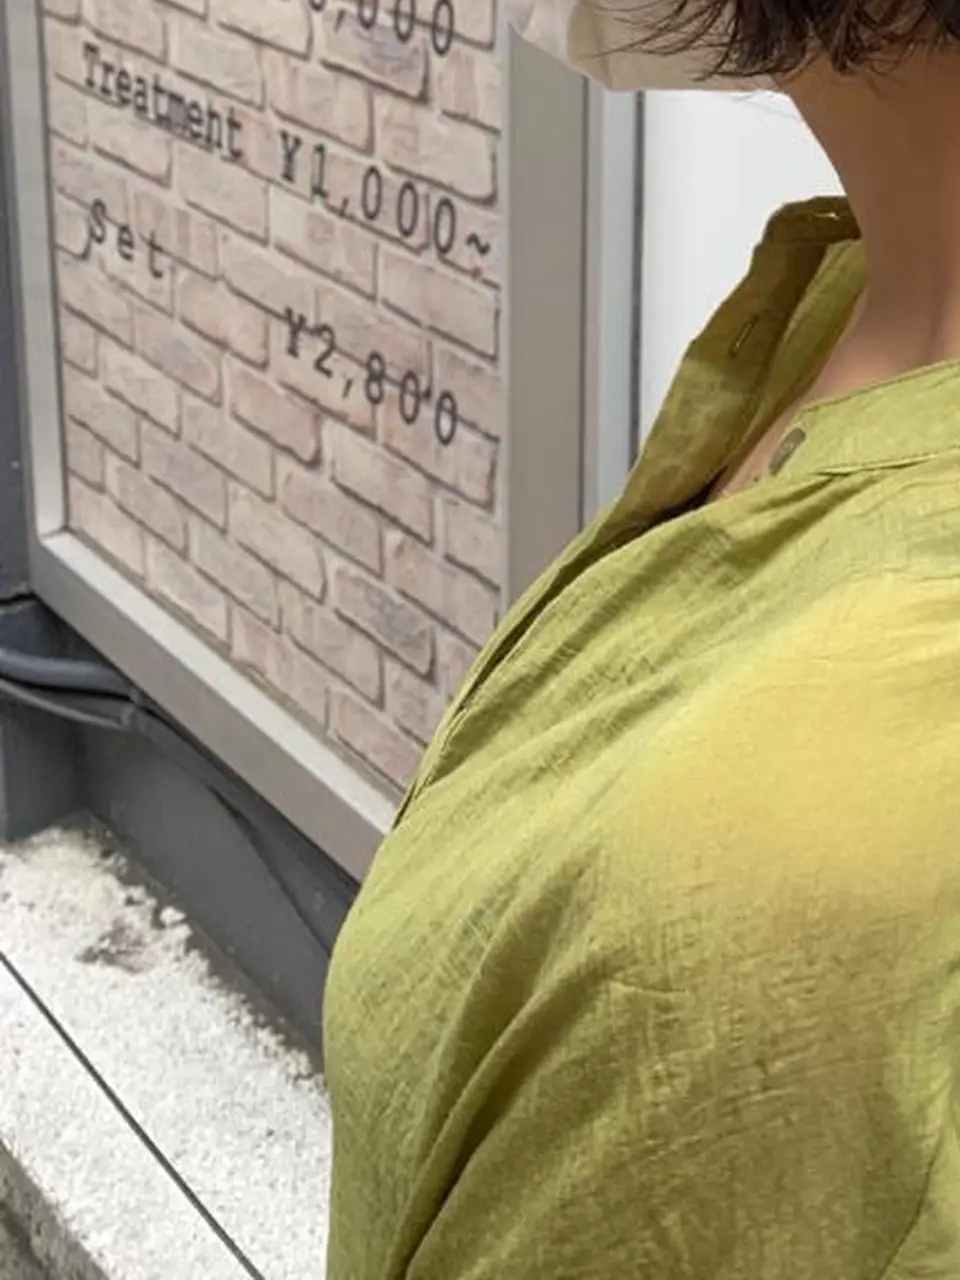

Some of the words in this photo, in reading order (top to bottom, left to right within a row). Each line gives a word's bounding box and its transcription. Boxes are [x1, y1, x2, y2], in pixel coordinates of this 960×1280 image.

[82, 41, 244, 161] Treatment
[88, 199, 165, 280] Set
[284, 307, 458, 446] ¥2,800
